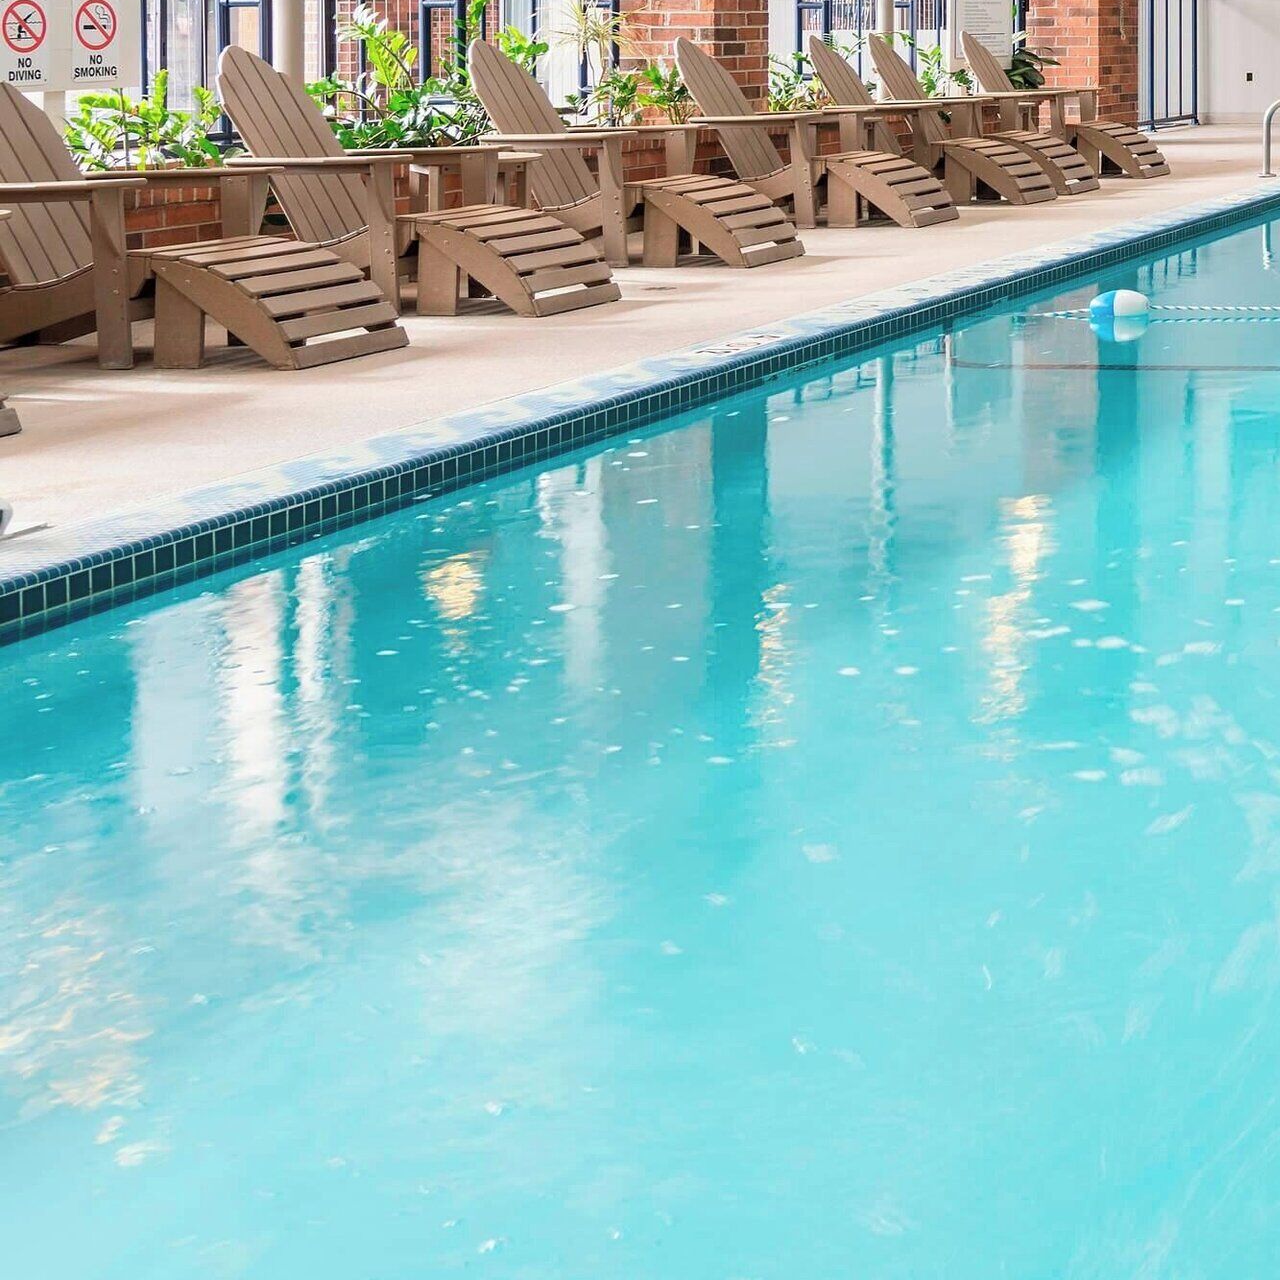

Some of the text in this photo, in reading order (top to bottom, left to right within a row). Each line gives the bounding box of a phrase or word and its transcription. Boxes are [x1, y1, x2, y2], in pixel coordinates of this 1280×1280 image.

[18, 57, 32, 68] NO
[89, 54, 103, 65] NO
[8, 69, 42, 81] DIVING
[74, 65, 118, 78] SMOKING
